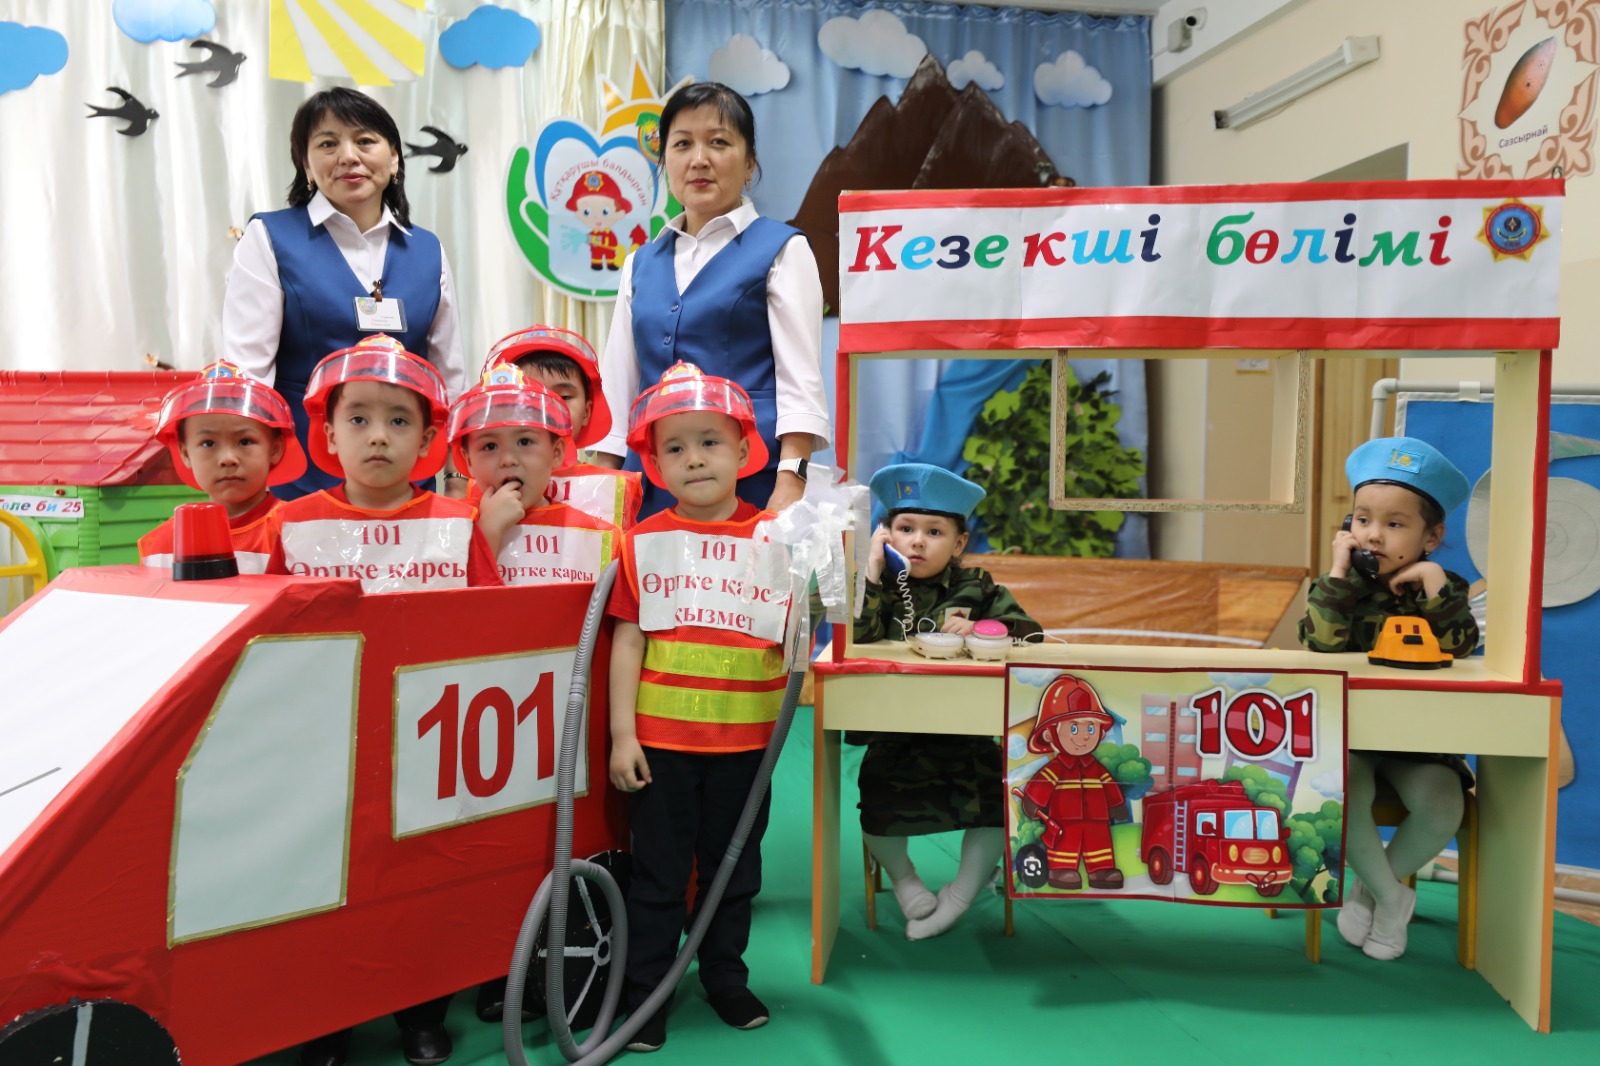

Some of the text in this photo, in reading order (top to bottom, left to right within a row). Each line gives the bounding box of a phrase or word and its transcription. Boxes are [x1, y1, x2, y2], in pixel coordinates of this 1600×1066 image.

[1206, 211, 1453, 267] бөлімі
[36, 500, 58, 512] би
[61, 501, 82, 513] 25
[361, 524, 402, 546] 101
[524, 534, 561, 555] 101
[700, 540, 737, 562] 101
[642, 572, 713, 599] Өртке
[417, 671, 555, 800] 101
[1190, 687, 1318, 762] 101
